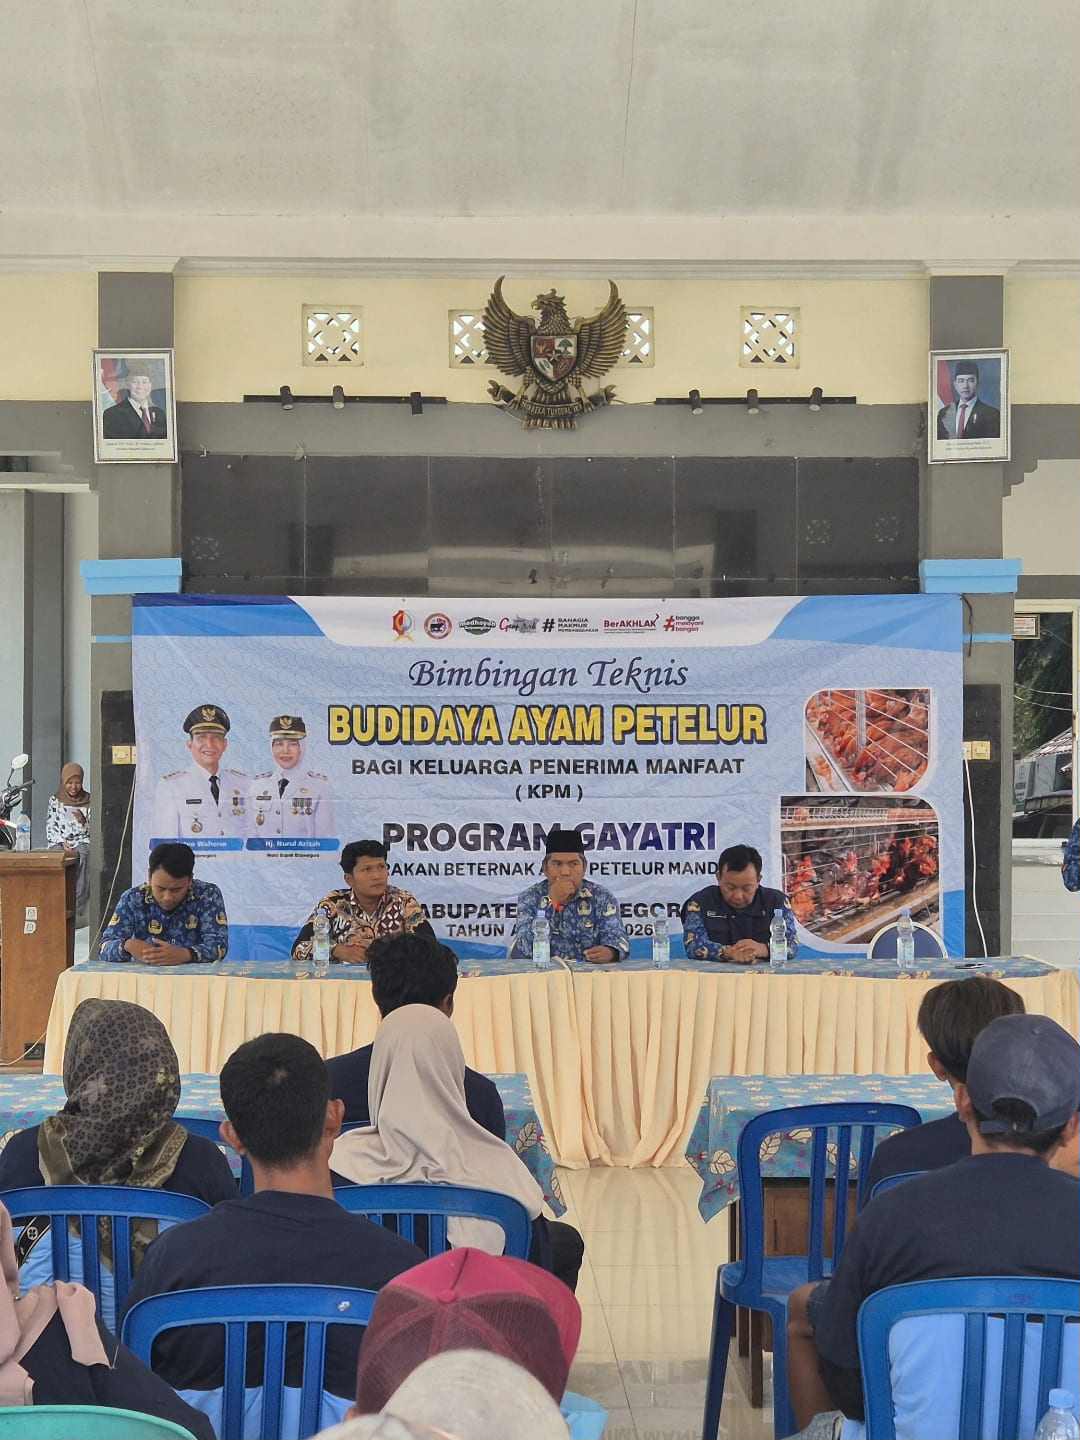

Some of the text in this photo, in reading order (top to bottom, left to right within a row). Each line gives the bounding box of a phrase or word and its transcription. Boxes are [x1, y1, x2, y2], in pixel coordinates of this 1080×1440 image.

[603, 616, 659, 628] BerAKHLAK
[409, 656, 689, 696] Bimbingan Teknis
[327, 703, 768, 746] BUDIDAYA AYAM PETELUR
[352, 758, 745, 775] BAGI KELUARGA PENERIMA MANFAAT
[387, 863, 535, 876] AKAN BETERNAK
[589, 862, 718, 875] PETELUR MAND
[422, 903, 518, 919] ABUPATE
[446, 924, 505, 937] TAHUN
[625, 923, 654, 936] 026
